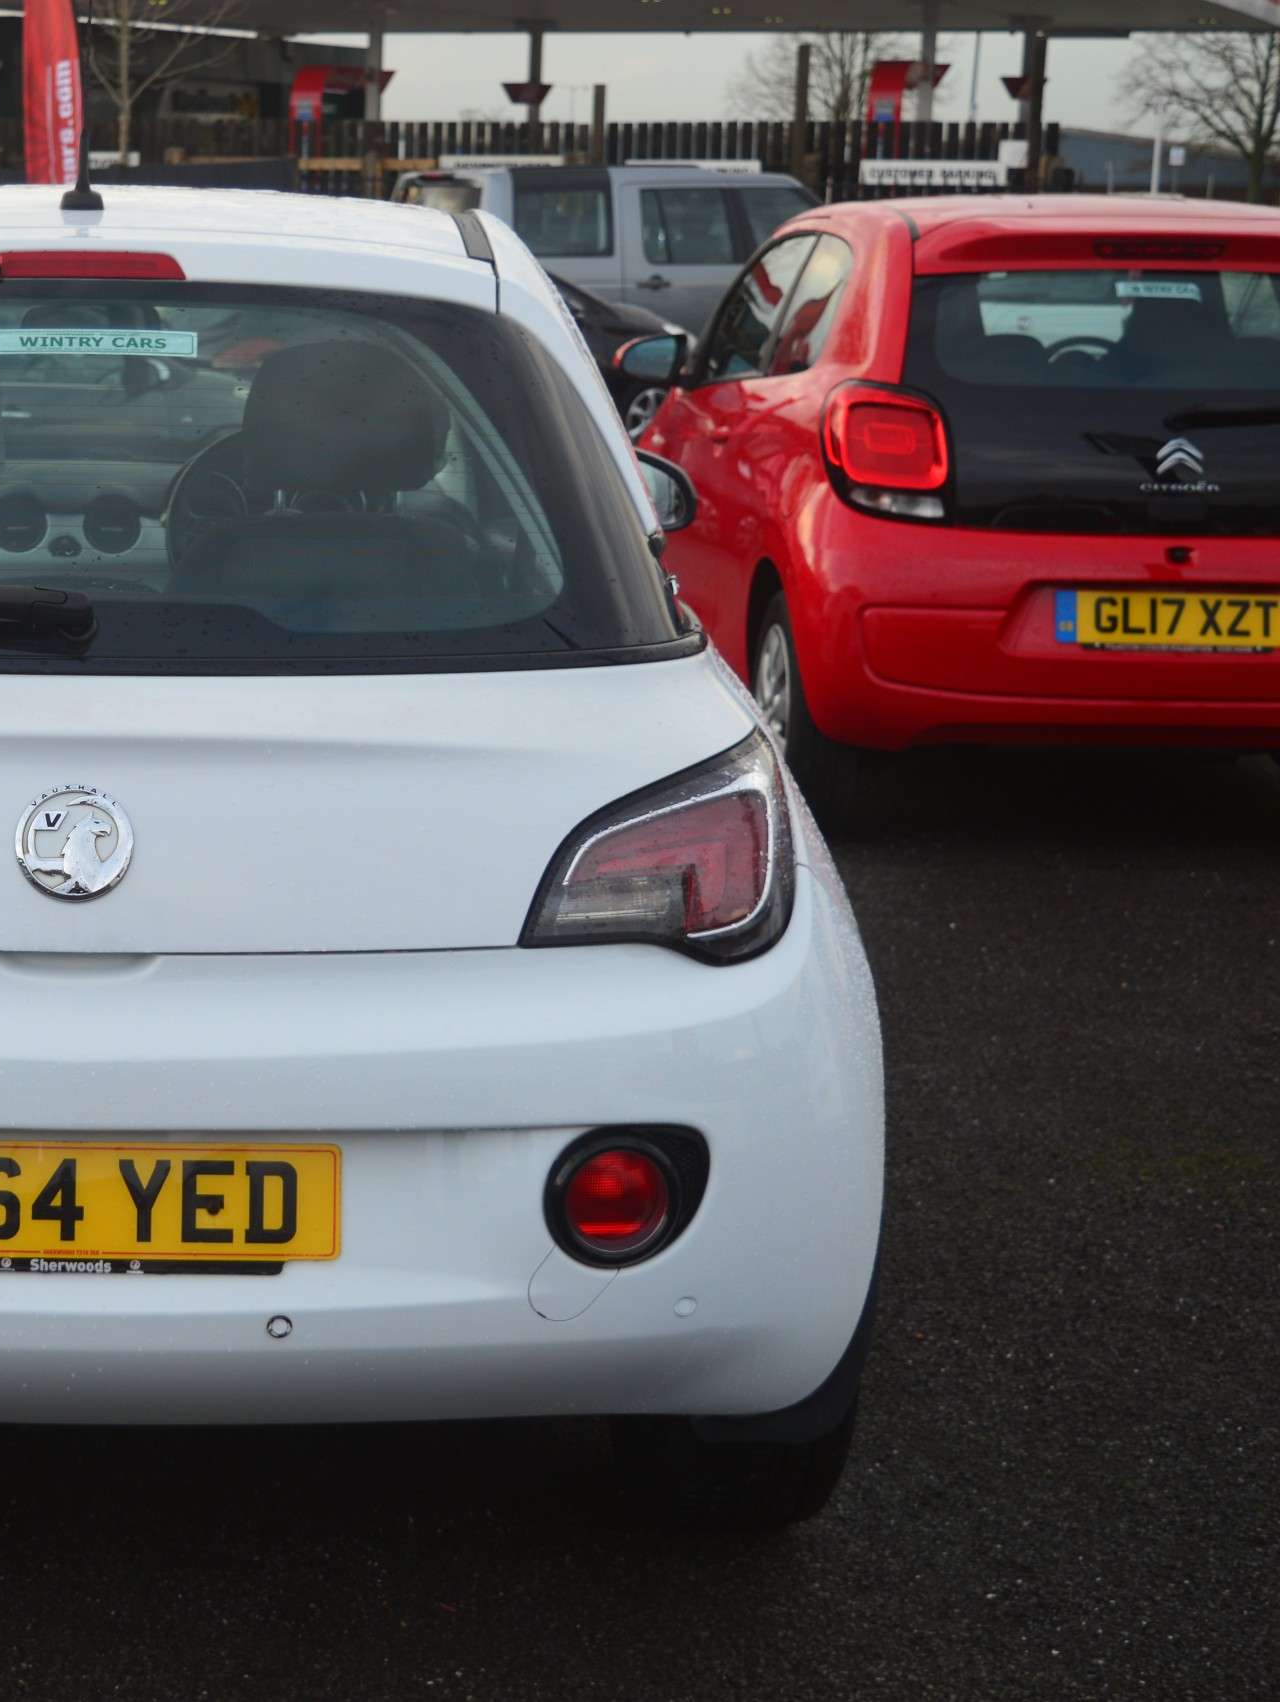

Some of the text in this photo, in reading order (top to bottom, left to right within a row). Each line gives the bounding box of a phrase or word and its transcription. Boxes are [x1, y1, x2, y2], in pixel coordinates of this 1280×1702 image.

[19, 336, 168, 350] WINTRY CARS
[1094, 597, 1278, 638] GL17 XZT
[118, 1158, 298, 1244] YED
[30, 1258, 112, 1273] Sherwoods
